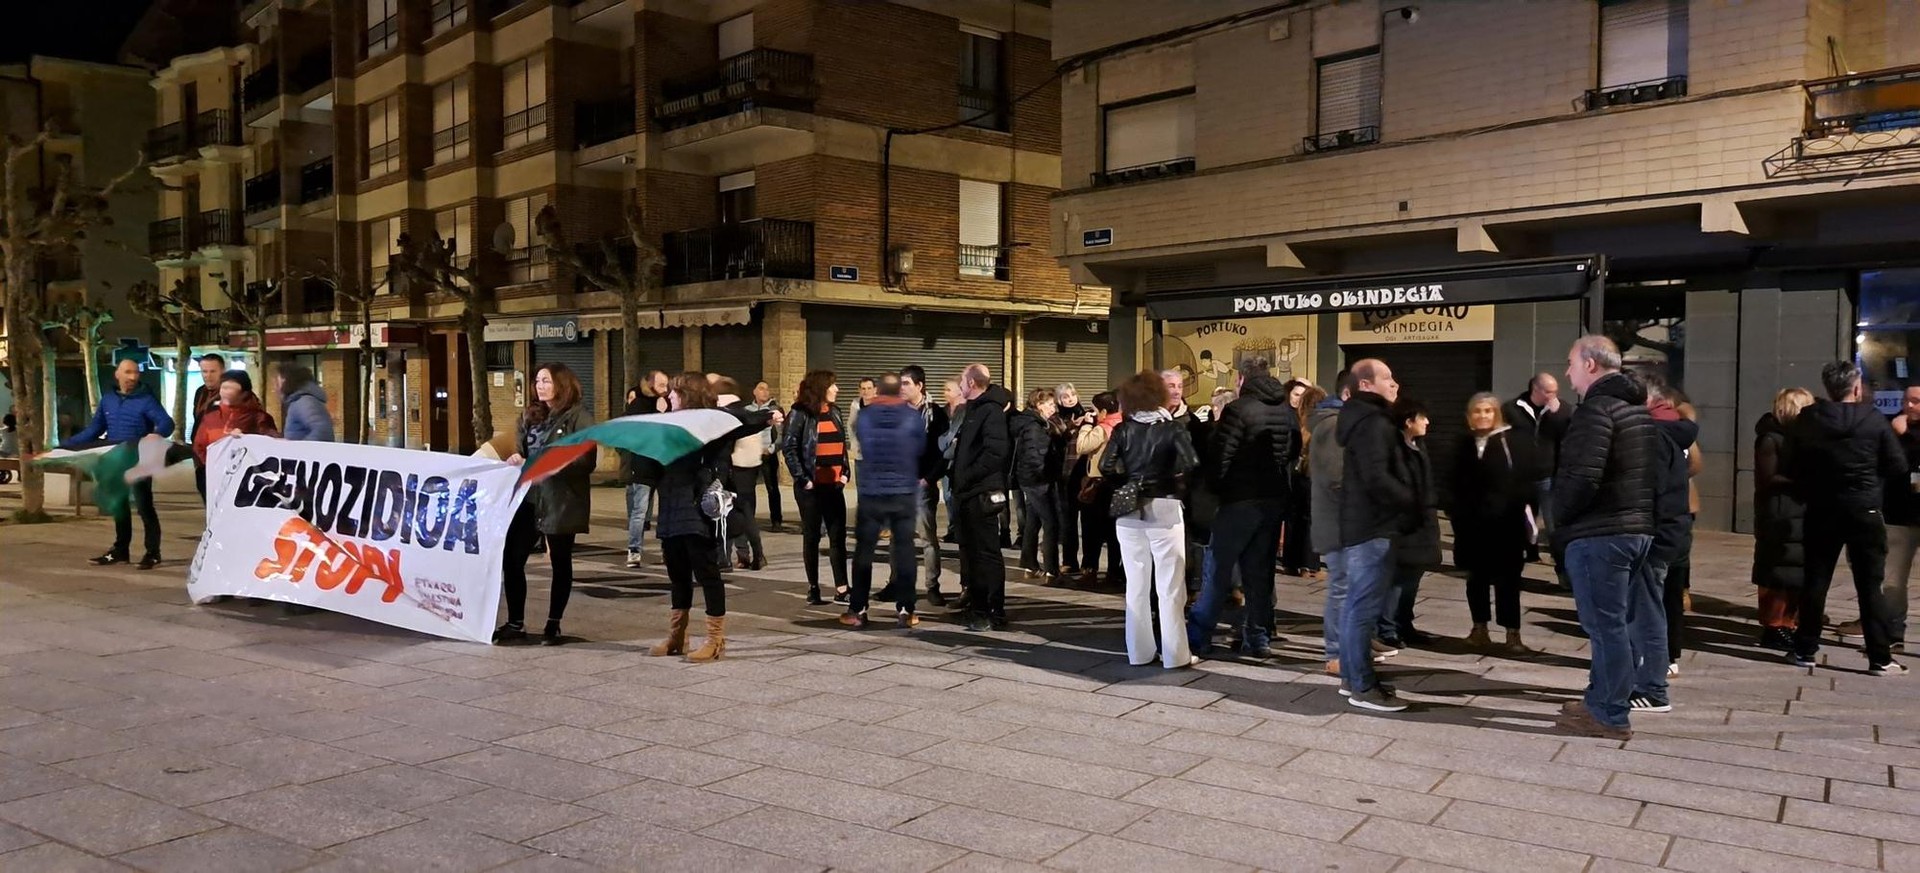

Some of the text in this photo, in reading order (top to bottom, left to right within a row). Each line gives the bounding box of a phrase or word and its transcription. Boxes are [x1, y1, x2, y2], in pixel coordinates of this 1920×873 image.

[1233, 293, 1323, 313] PORTUKO
[535, 324, 564, 338] Allianz
[1196, 321, 1248, 338] PORTUKO
[1372, 320, 1454, 334] OKINDEGIA
[234, 456, 480, 555] GENOZIDIOA
